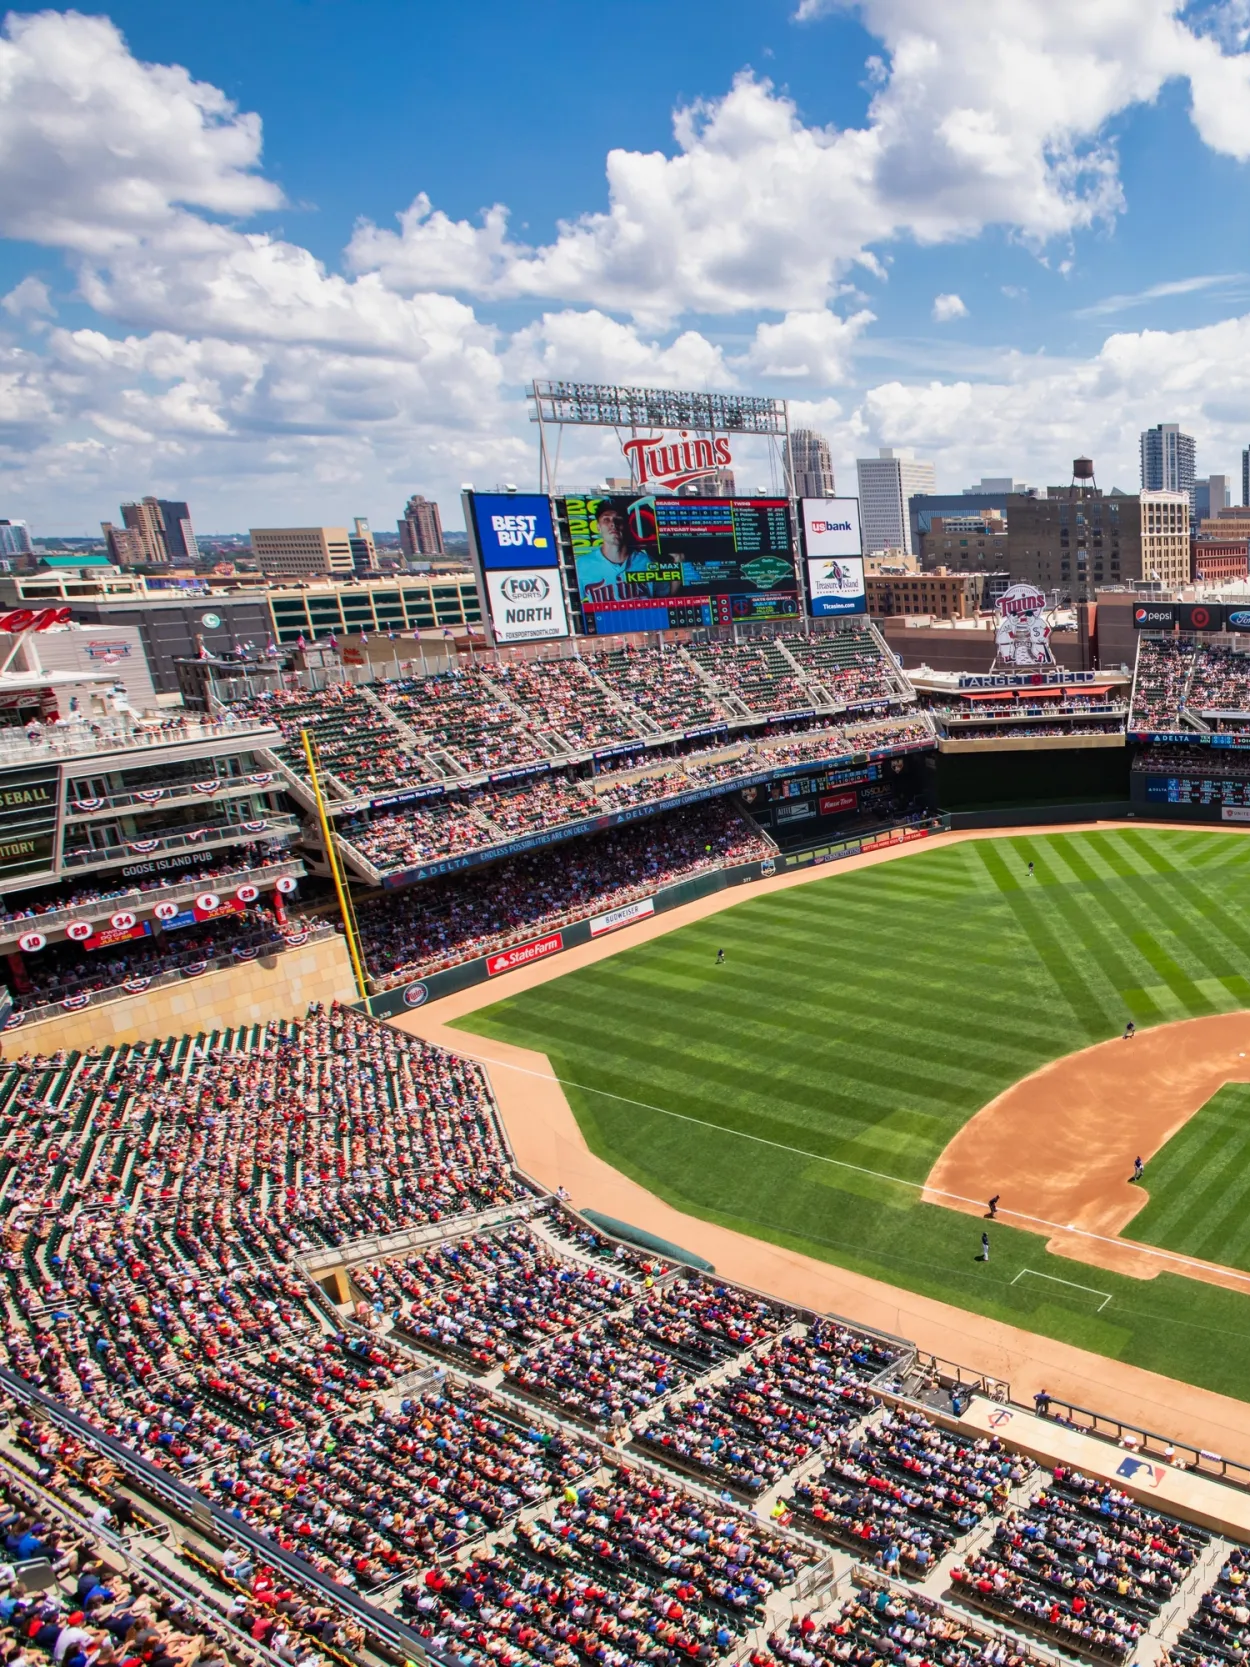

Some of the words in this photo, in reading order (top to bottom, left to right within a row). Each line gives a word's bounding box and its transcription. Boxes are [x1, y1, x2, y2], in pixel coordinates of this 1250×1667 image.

[622, 431, 732, 491] Twins
[491, 515, 537, 532] BEST
[497, 531, 535, 546] BUY
[627, 571, 681, 582] KEPLER
[509, 578, 541, 593] FOX
[815, 581, 838, 590] Treasure
[842, 579, 859, 589] Island
[996, 593, 1046, 617] Twins
[505, 607, 552, 623] NORTH
[1148, 611, 1172, 622] pepsi
[959, 676, 1029, 688] TARGET
[1047, 672, 1096, 684] FIELD
[535, 764, 549, 773] Porch
[773, 771, 796, 779] Chavez
[427, 788, 443, 797] Porch
[659, 798, 682, 810] PROUDLY
[681, 790, 711, 803] CONNECTING
[711, 786, 725, 796] TWINS
[725, 783, 736, 793] FANS
[736, 781, 743, 789] TO
[743, 778, 751, 787] THE
[626, 806, 654, 820] DELTA
[480, 846, 509, 861] ENDLESS
[509, 834, 551, 855] POSSIBILITIES
[551, 831, 563, 841] ARE
[563, 828, 573, 837] ON
[863, 843, 877, 851] GETTING
[122, 863, 155, 877] GOOSE
[157, 855, 192, 870] ISLAND
[192, 851, 213, 863] PUB
[430, 857, 470, 875] DELTA
[283, 880, 290, 889] 3
[204, 897, 212, 907] 6
[160, 906, 173, 916] 14
[207, 910, 225, 918] JULY
[605, 906, 639, 923] BUDWEISER
[116, 915, 131, 927] 34
[73, 926, 88, 937] 28
[112, 930, 129, 938] CAP
[26, 936, 41, 949] 10
[100, 936, 120, 945] JULY
[406, 987, 426, 1003] Twins
